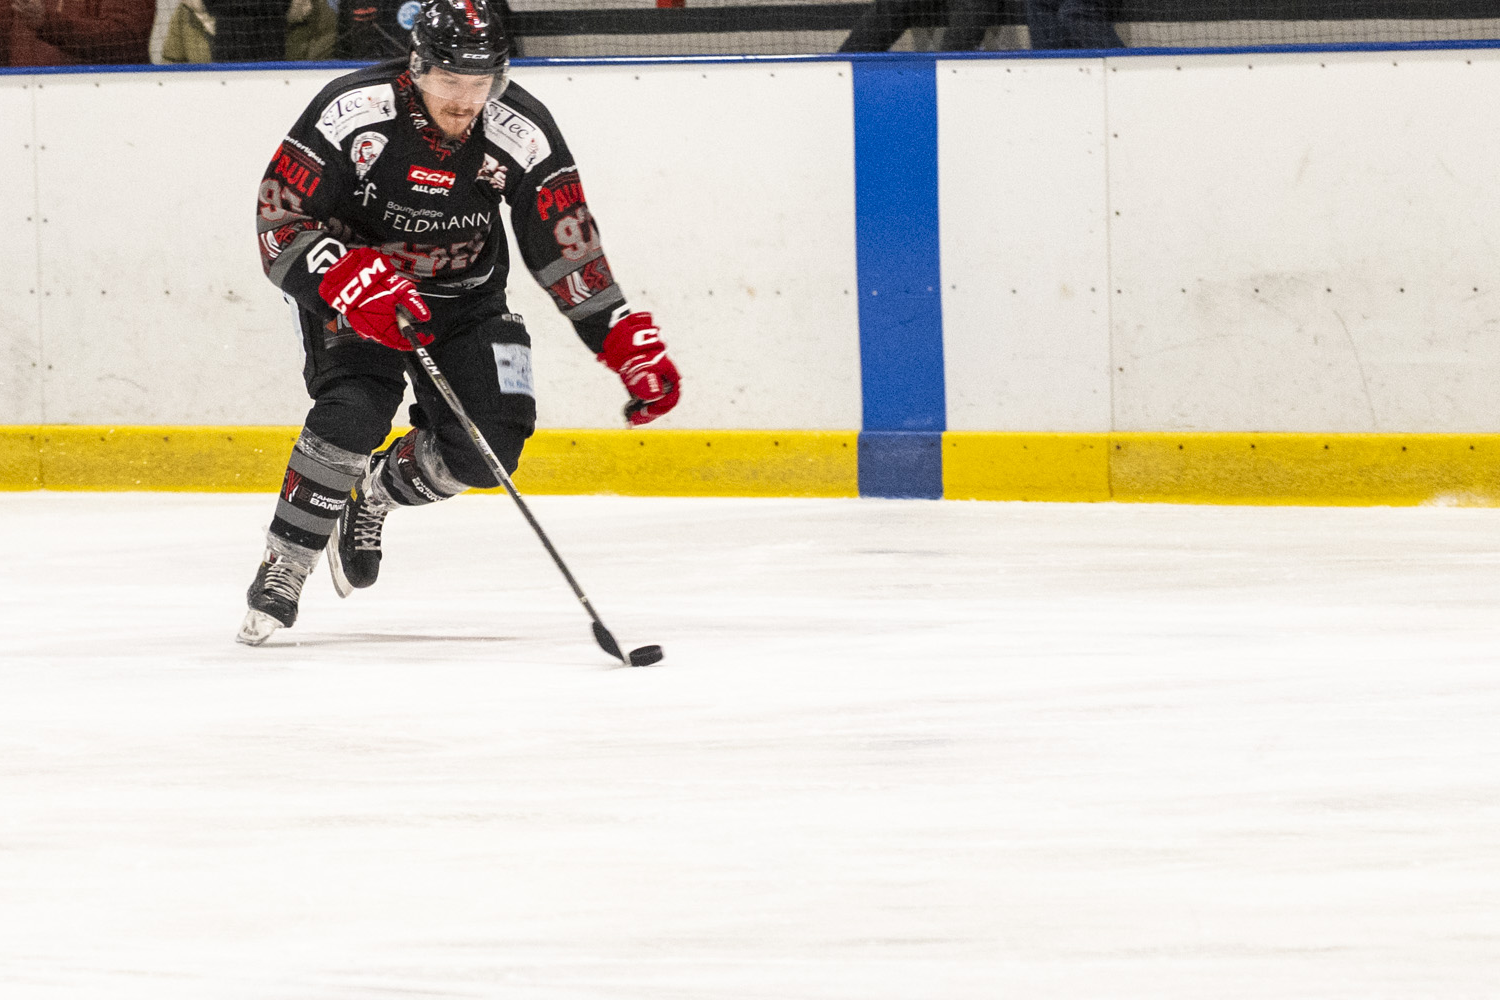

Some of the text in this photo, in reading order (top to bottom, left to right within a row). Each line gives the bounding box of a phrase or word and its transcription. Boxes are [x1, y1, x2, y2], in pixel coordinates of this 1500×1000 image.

[411, 170, 456, 185] CCM
[411, 184, 429, 195] ALL
[386, 201, 444, 218] Baumpflege
[382, 210, 491, 233] FELDMANN
[416, 347, 441, 376] CCM
